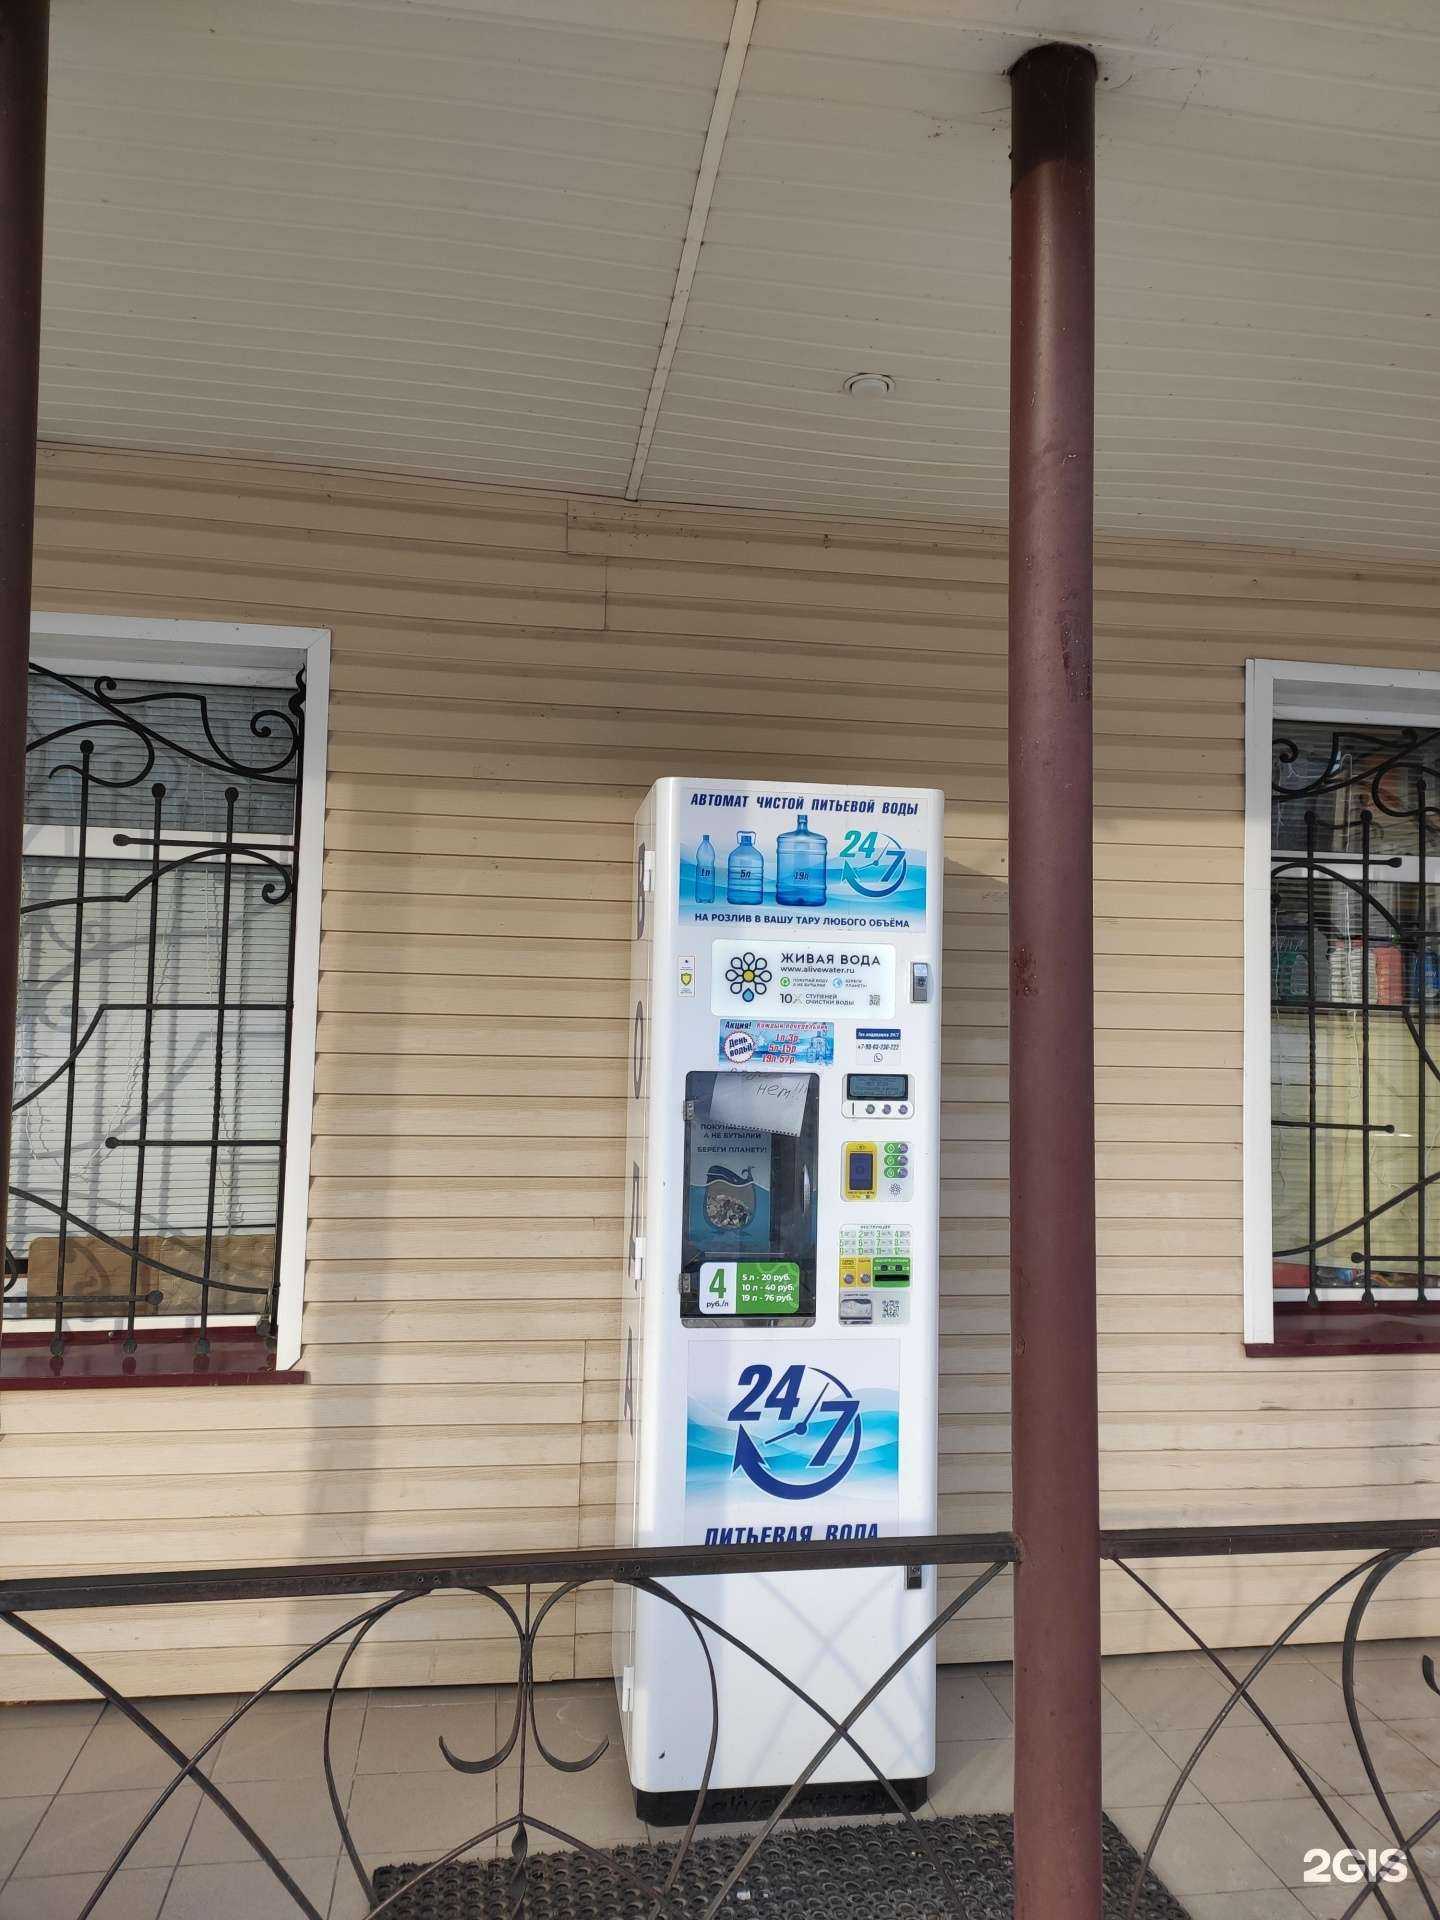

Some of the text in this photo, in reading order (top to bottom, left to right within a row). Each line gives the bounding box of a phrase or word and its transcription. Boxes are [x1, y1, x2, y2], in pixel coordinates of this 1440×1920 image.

[690, 793, 919, 816] АВТОМАТ ЧИСТОЙ ПИТЬЕВОЙ ВОДЫ
[840, 830, 878, 858] 24
[880, 850, 906, 882] 7
[694, 913, 910, 928] НА РОЗЛИВ В ВАШУ ТАРУ ЛЮБОГО ОБЪЁМА
[780, 952, 880, 967] ЖИВАЯ ВОДА
[780, 966, 855, 974] www.alivewater.ru
[780, 994, 792, 1004] 10
[725, 1021, 752, 1030] Акция!
[729, 1036, 748, 1048] День
[709, 1268, 726, 1298] 4
[773, 1274, 790, 1282] руб.
[777, 1284, 795, 1293] руб.
[706, 1300, 729, 1308] руб./л
[776, 1294, 793, 1303] руб.
[727, 1364, 806, 1422] 24
[808, 1400, 860, 1467] 7
[705, 1525, 813, 1546] ПИТЬЕВАЯ
